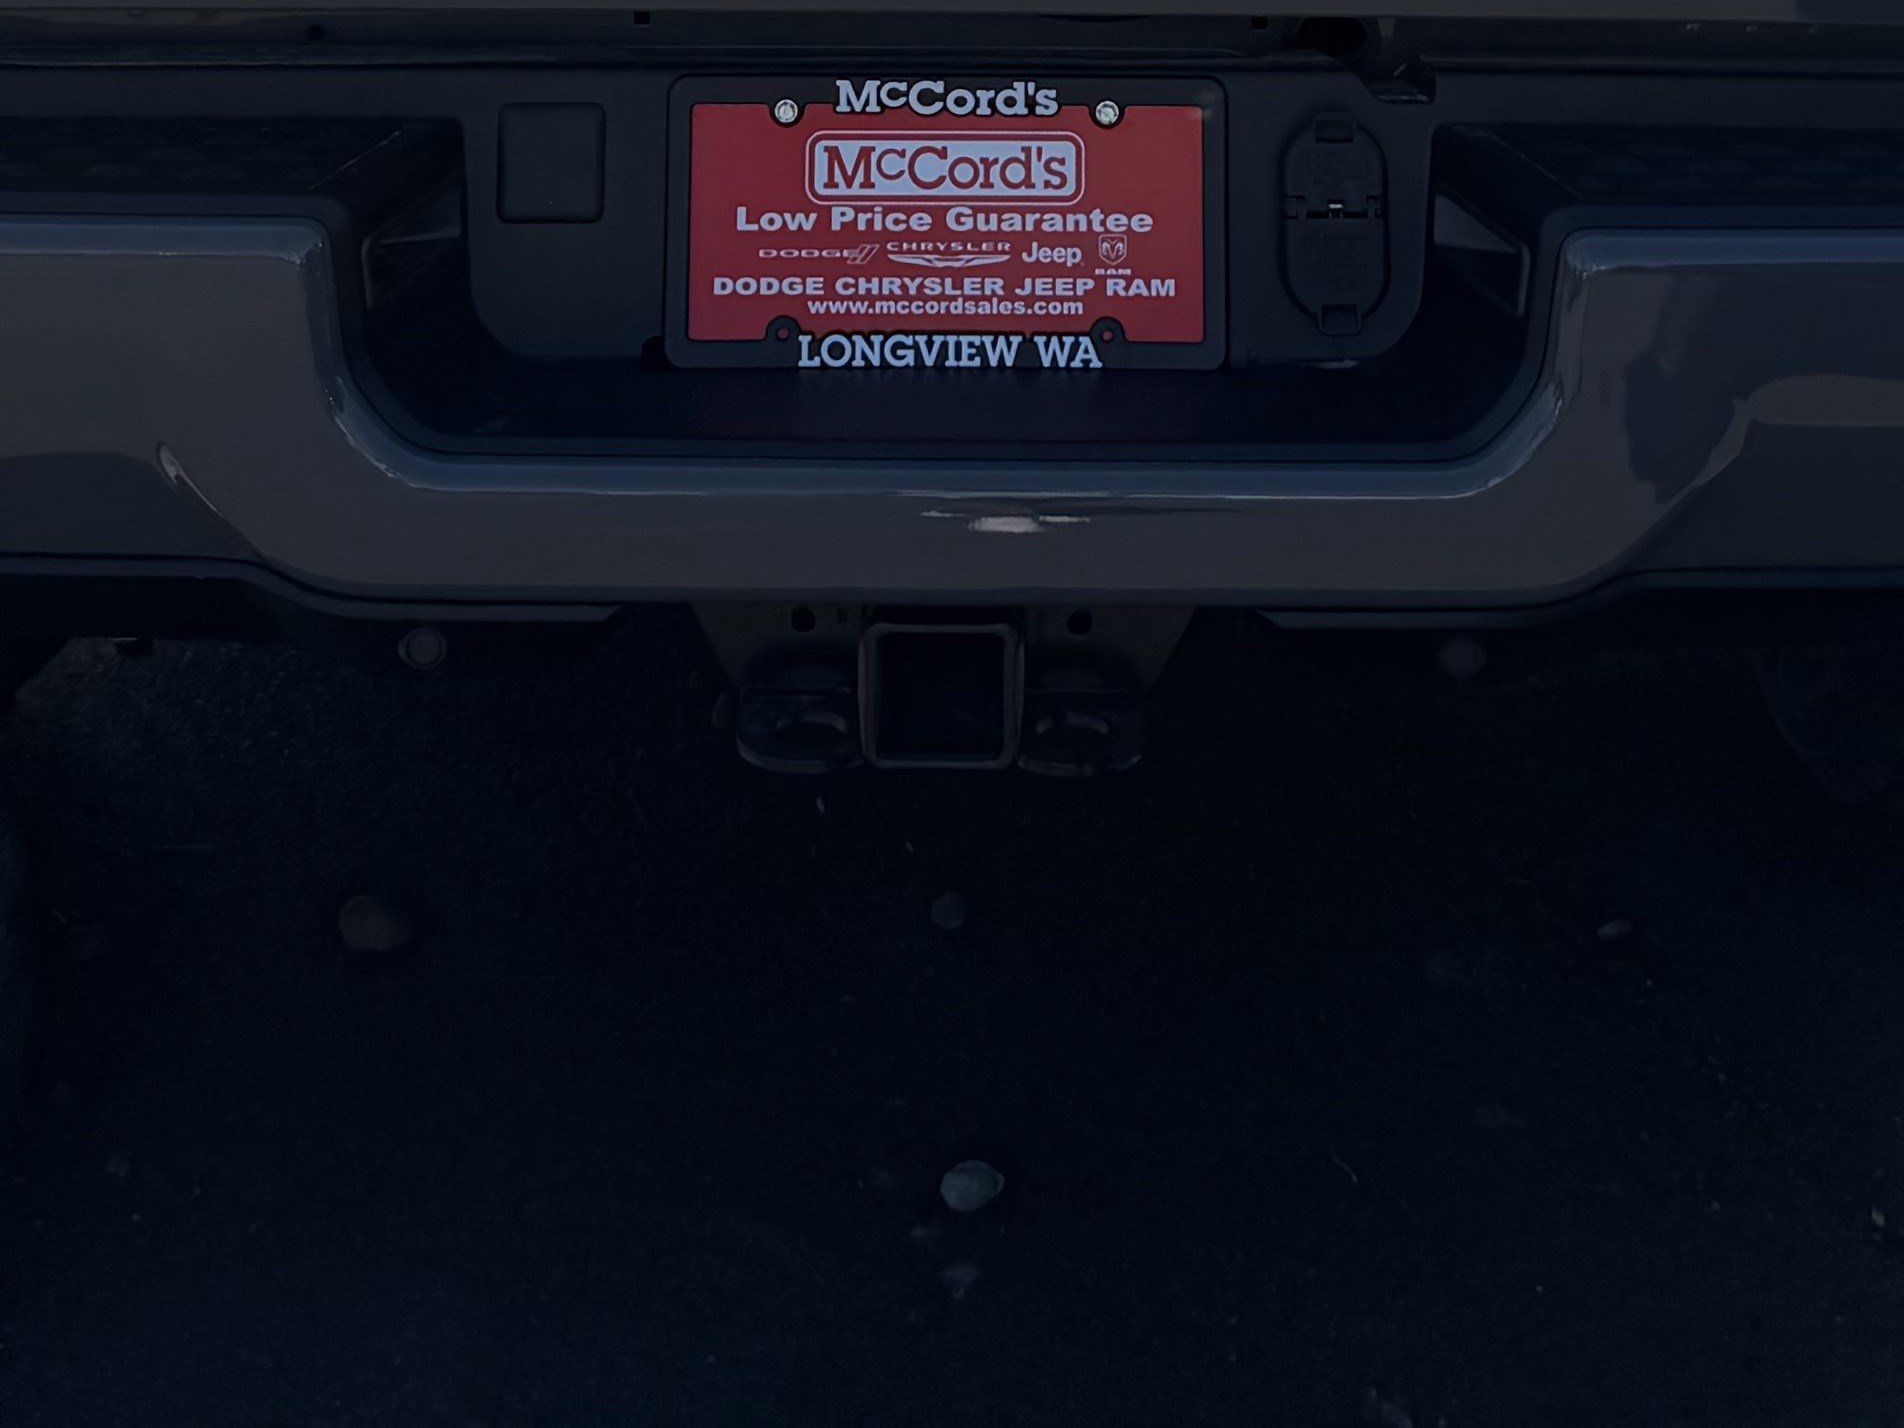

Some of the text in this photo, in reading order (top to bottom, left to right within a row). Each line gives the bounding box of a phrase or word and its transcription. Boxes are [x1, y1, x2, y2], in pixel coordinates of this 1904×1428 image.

[836, 79, 1059, 116] McCord's
[823, 145, 1068, 190] McCord's
[736, 206, 1153, 233] Low Price Guarantee
[886, 241, 1011, 251] CHRYSLER
[1021, 241, 1083, 266] Jeep
[1094, 268, 1132, 276] RAM
[713, 276, 1176, 297] DODGE CHRYSLER JEEP RAM
[807, 298, 1084, 315] www.mccordsales.com
[798, 334, 1102, 369] LONGVIEW WA
